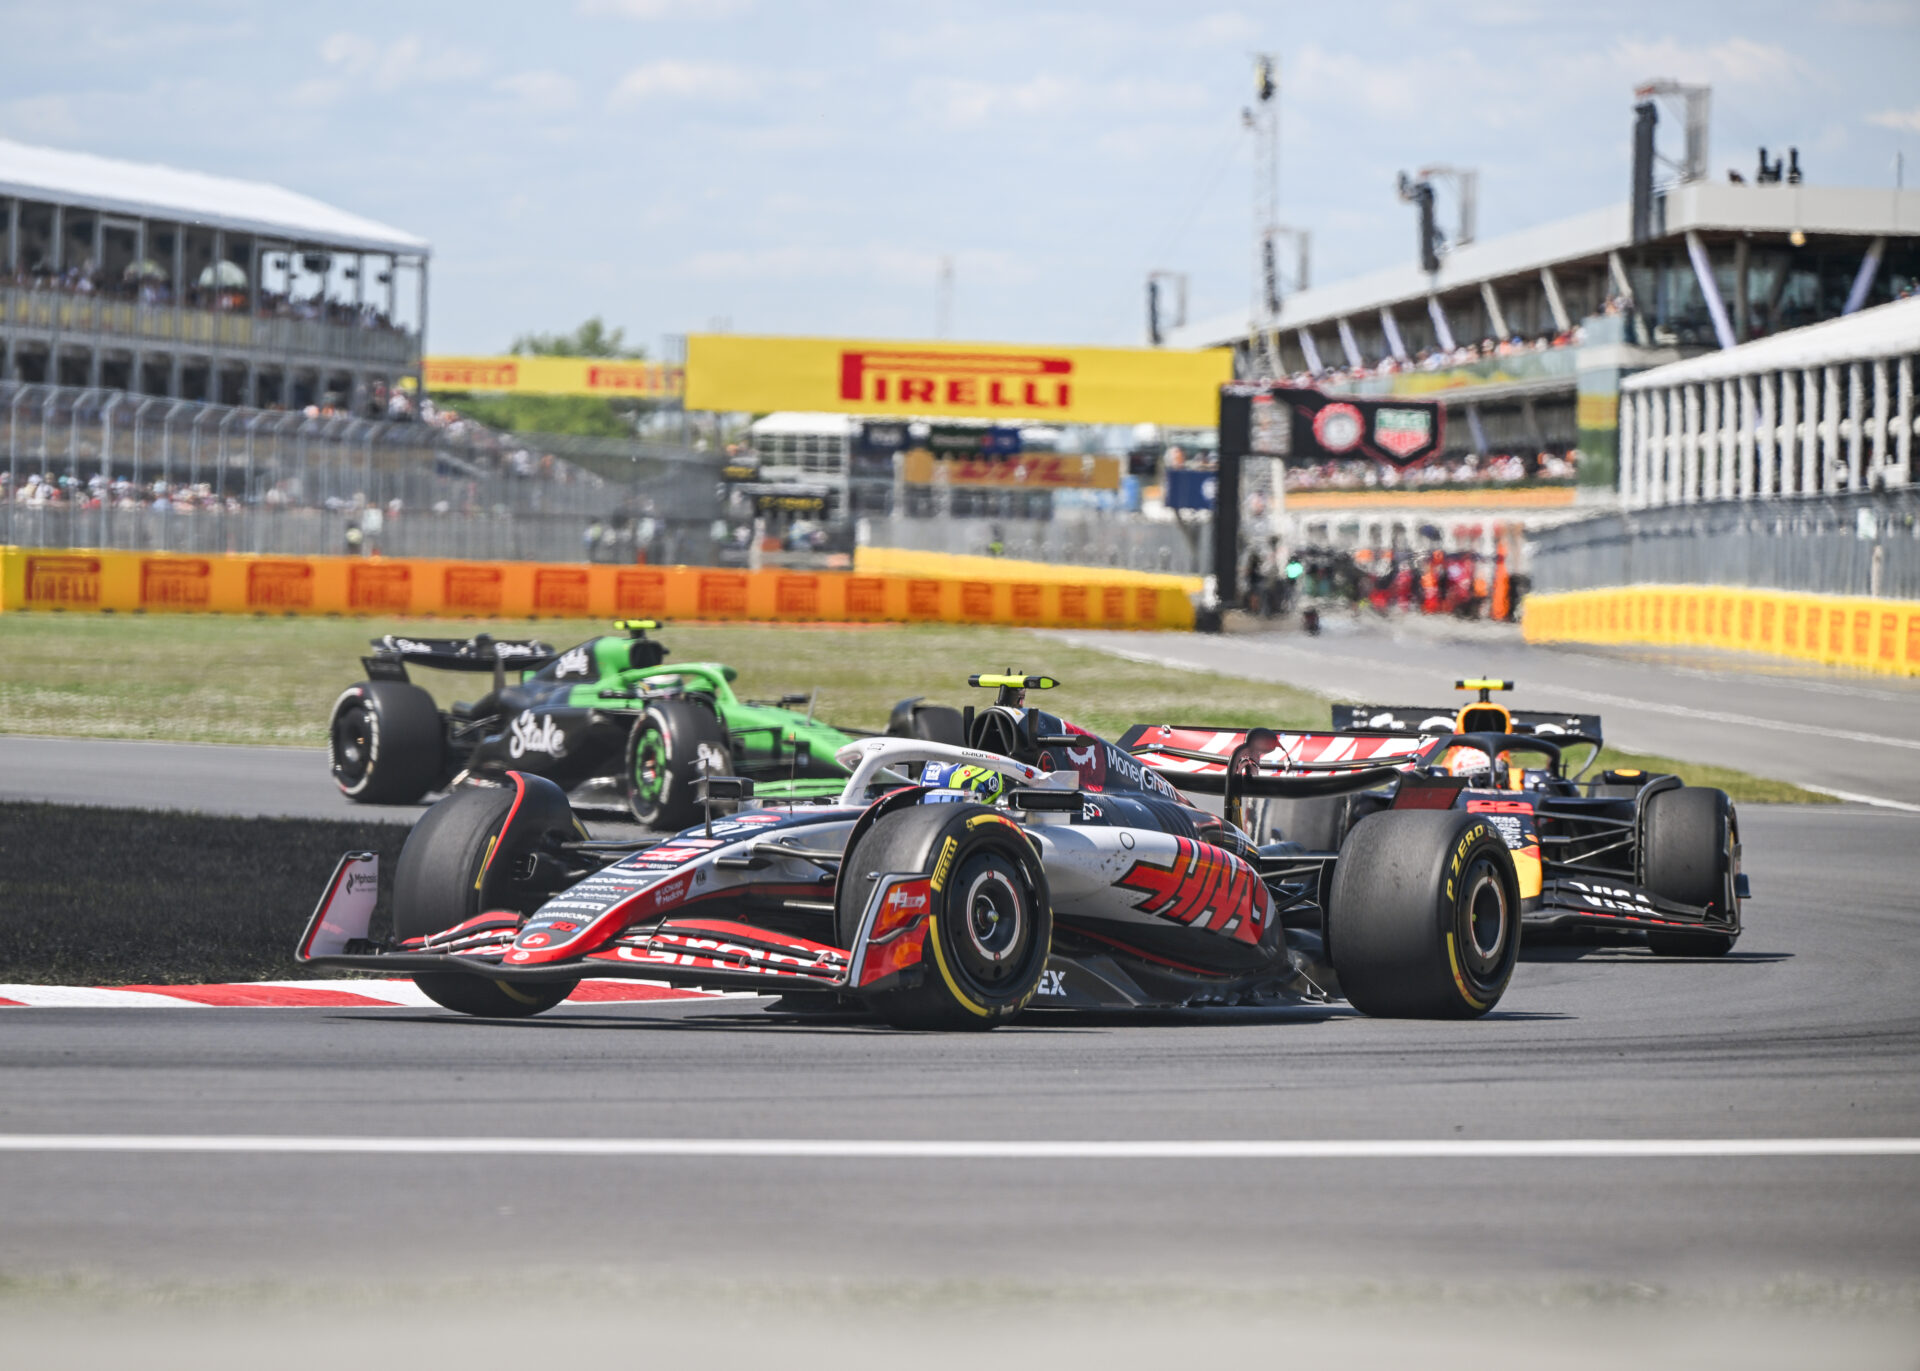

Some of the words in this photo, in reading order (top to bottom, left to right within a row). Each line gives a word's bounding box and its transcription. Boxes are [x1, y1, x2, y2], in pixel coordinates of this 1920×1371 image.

[840, 350, 1073, 408] PIRELLI
[510, 709, 567, 759] Stake
[1106, 745, 1178, 801] MoneyGram
[930, 835, 958, 892] PIRELLI
